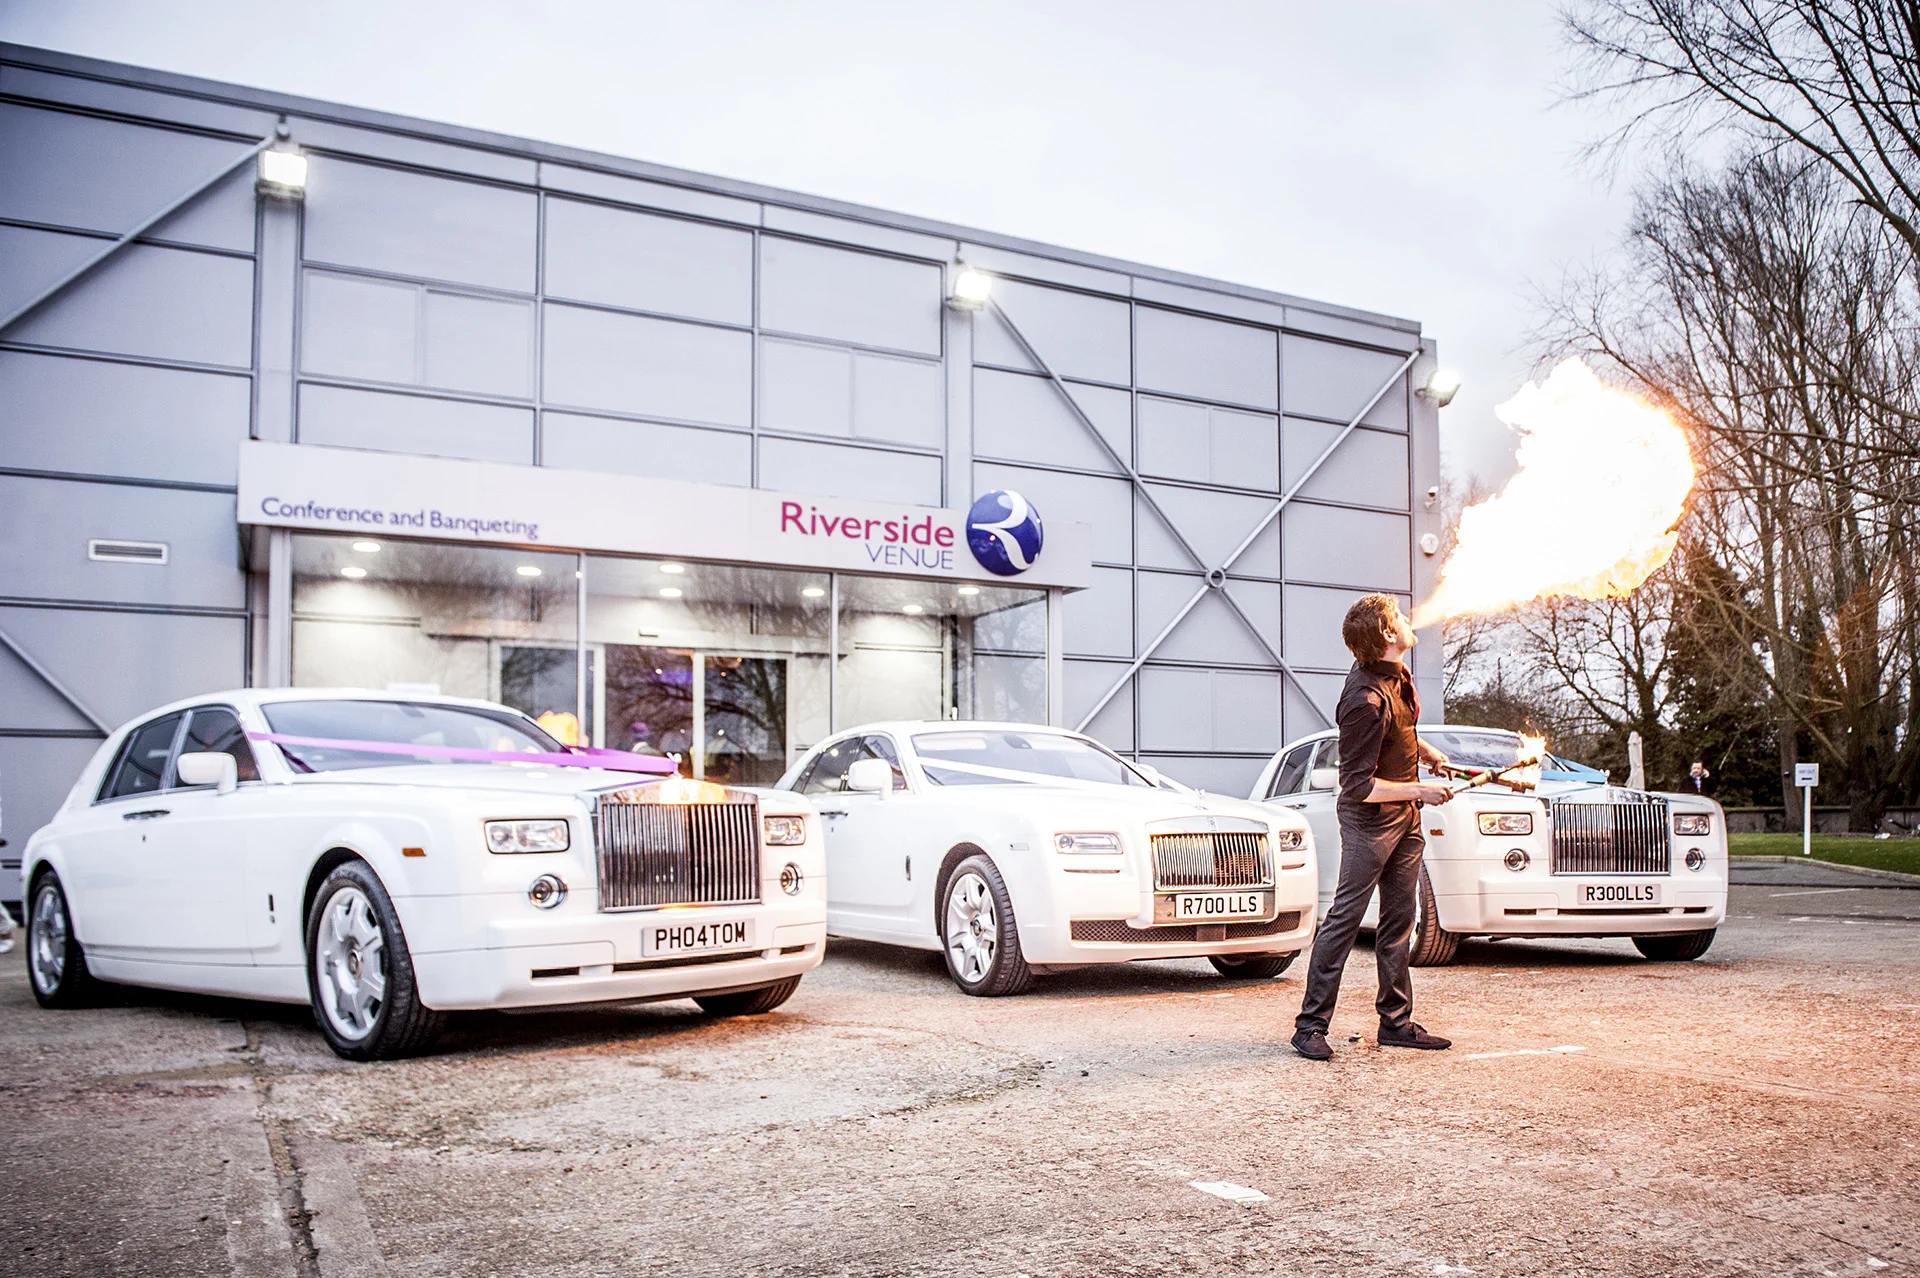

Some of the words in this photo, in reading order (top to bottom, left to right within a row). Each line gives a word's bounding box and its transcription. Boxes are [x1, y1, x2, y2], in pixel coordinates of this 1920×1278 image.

[261, 497, 384, 524] Conference
[389, 509, 425, 528] and
[429, 510, 540, 541] Banqueting
[780, 501, 955, 548] Riverside
[865, 543, 953, 570] VENUE
